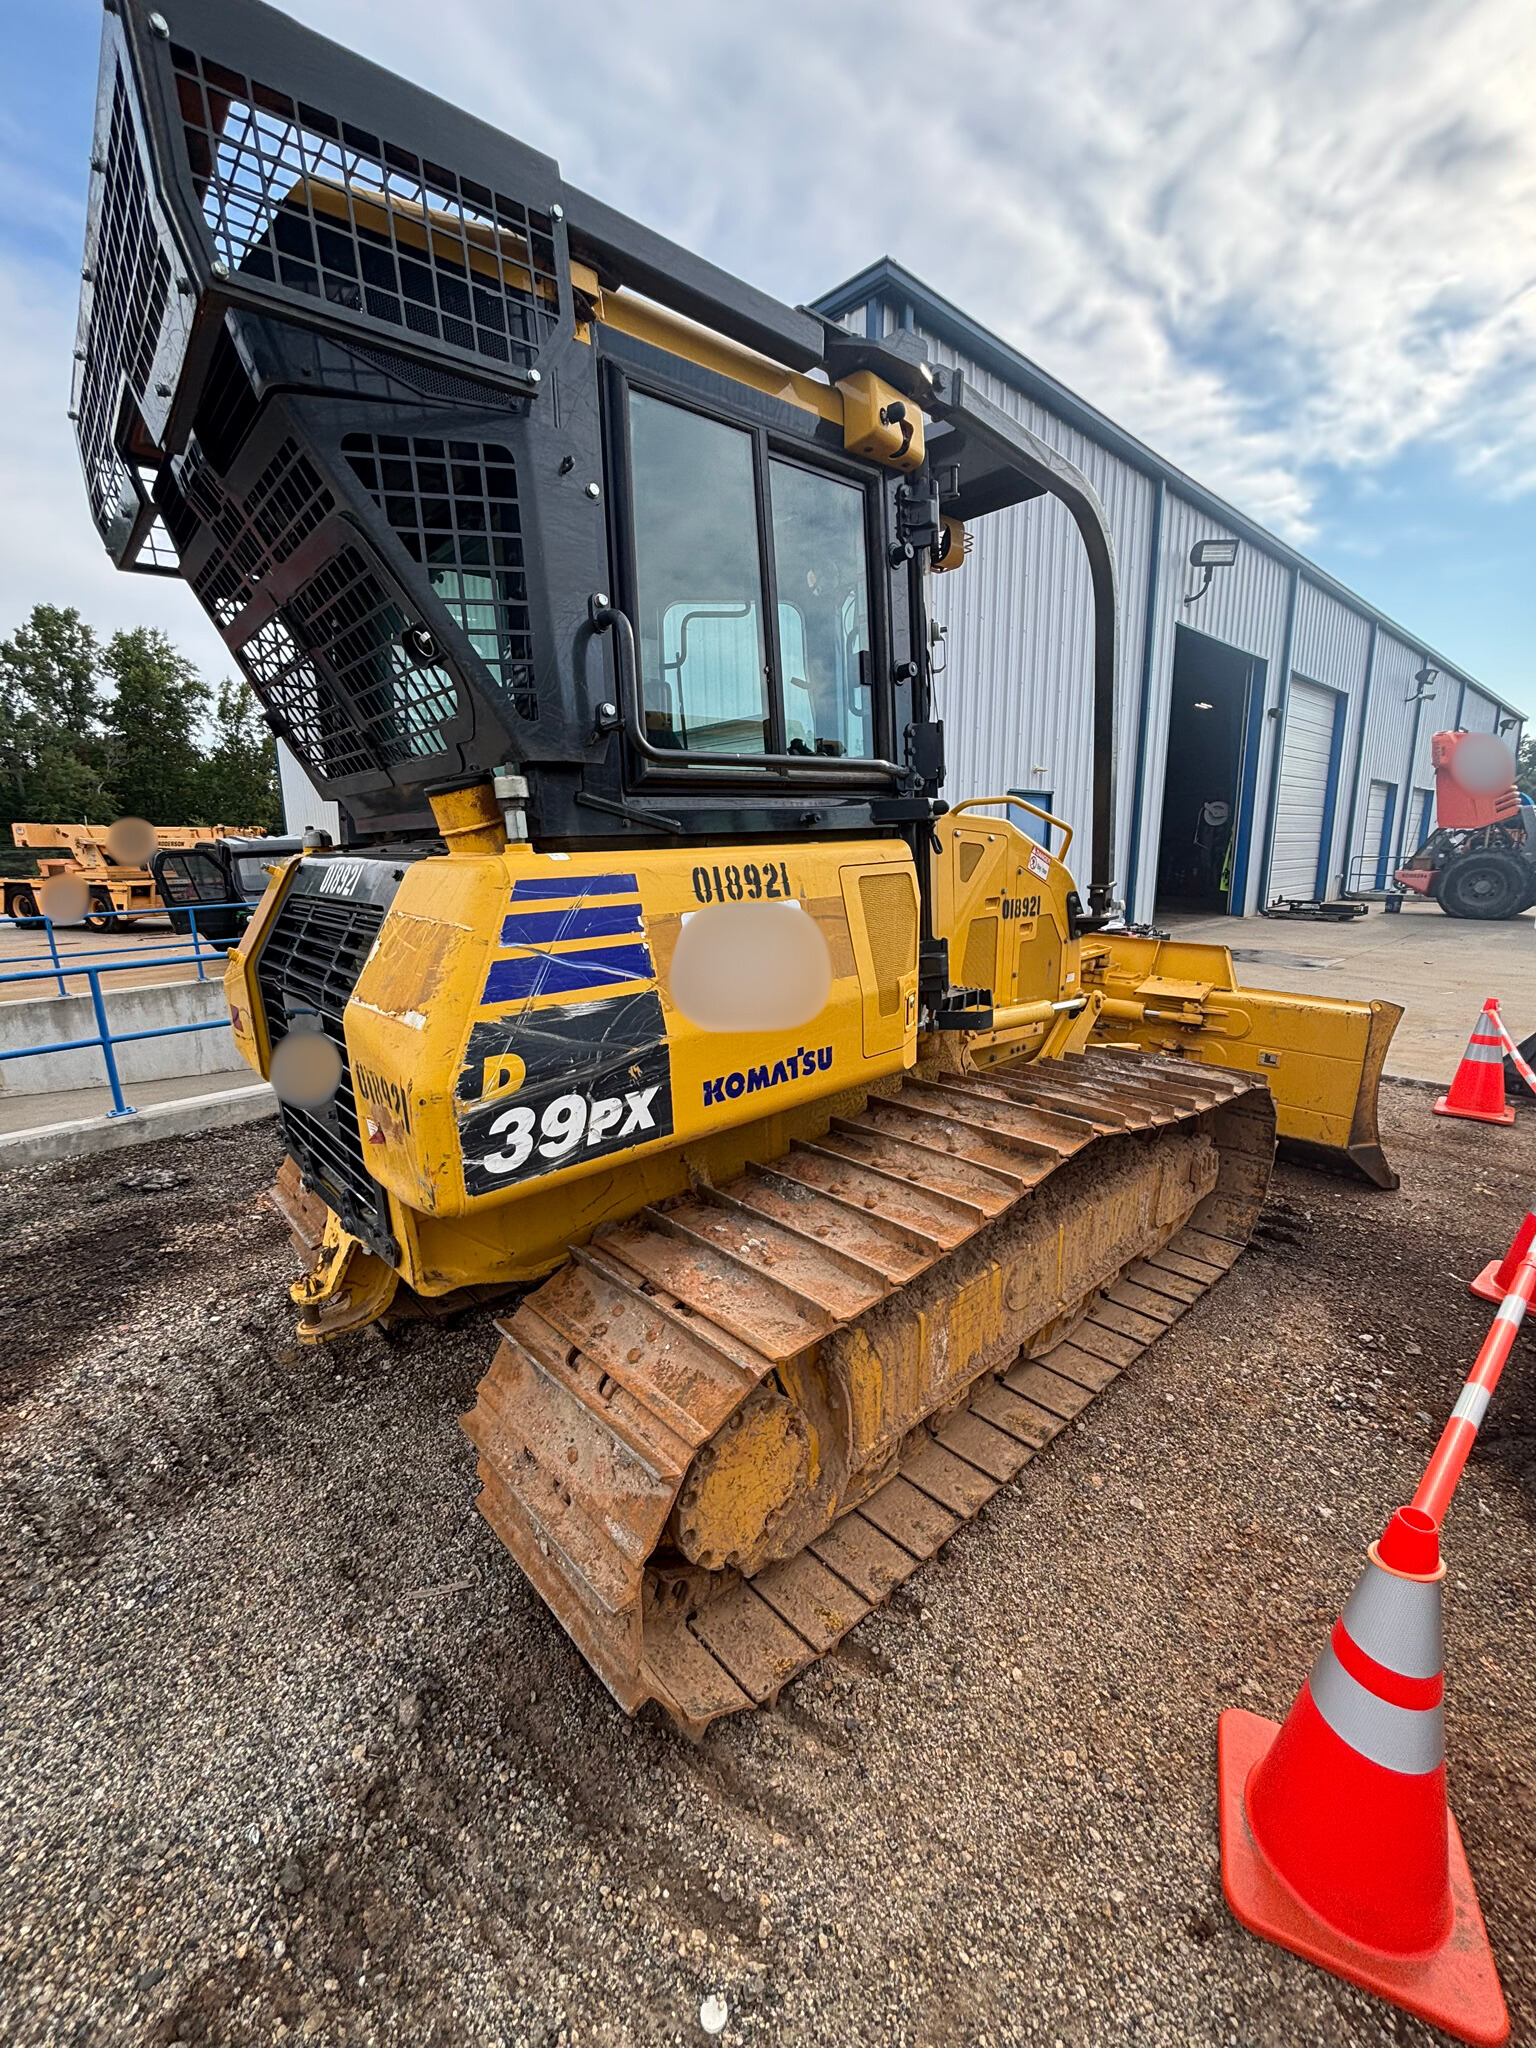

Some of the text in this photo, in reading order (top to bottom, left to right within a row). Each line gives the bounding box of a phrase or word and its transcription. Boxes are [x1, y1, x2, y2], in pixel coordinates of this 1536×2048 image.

[319, 863, 365, 896] 018921
[692, 862, 792, 903] 018921
[1002, 895, 1041, 919] 018921
[481, 1053, 526, 1102] D
[702, 1046, 833, 1107] KOMATSU
[483, 1085, 660, 1174] 39PX
